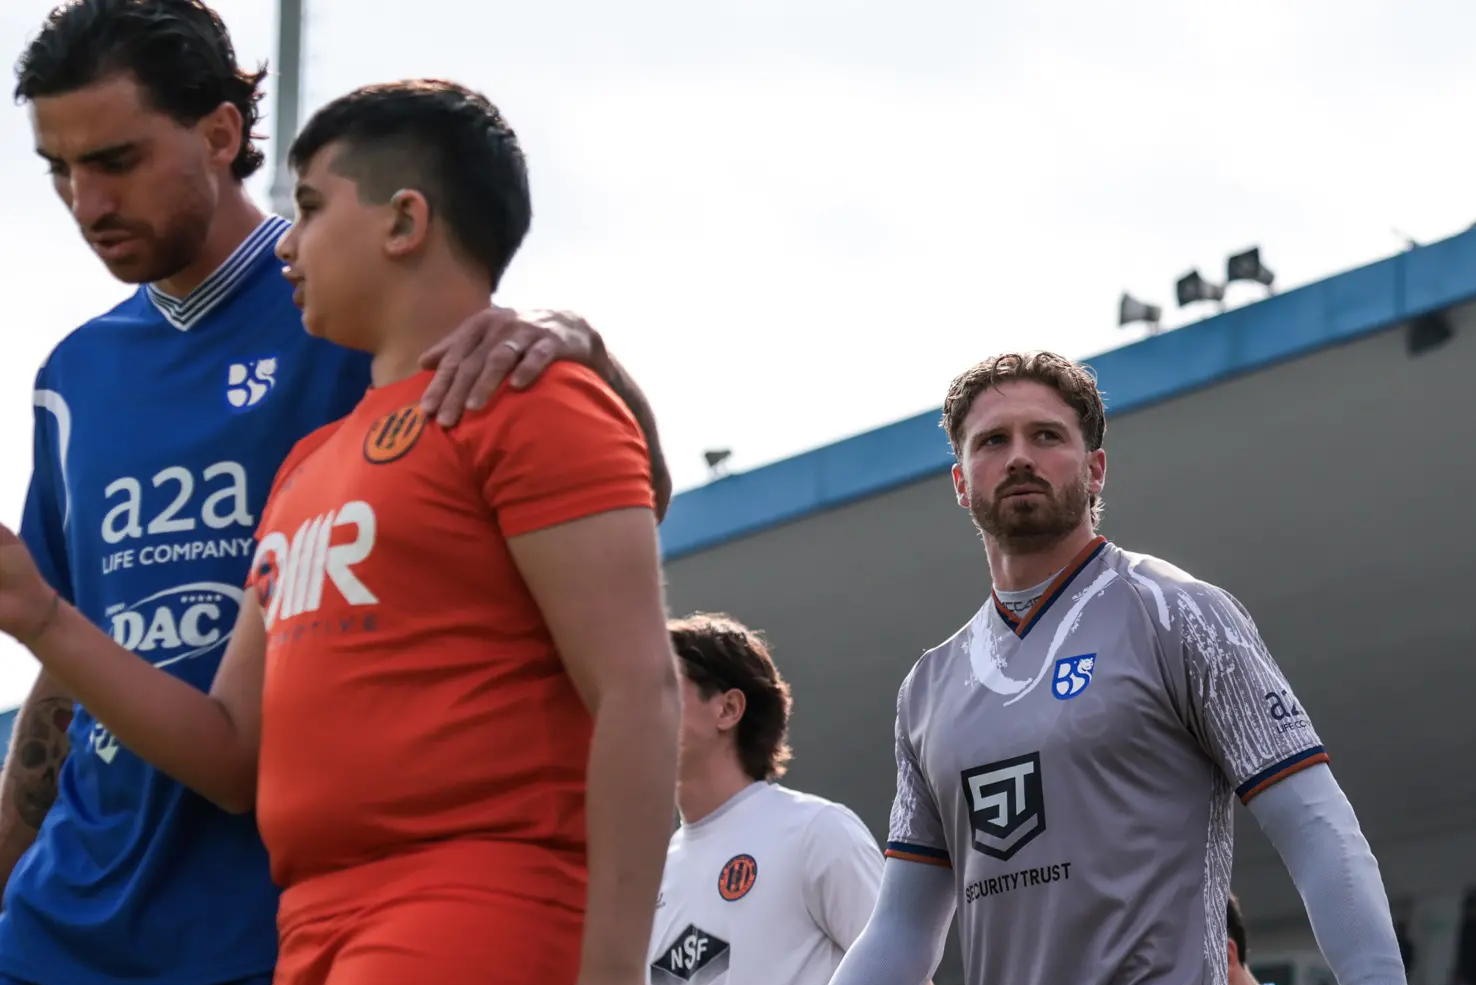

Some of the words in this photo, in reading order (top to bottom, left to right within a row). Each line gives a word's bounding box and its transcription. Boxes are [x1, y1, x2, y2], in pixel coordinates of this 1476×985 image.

[101, 461, 255, 544] a2a
[102, 549, 134, 574] LIFE
[139, 538, 253, 565] COMPANY
[112, 603, 221, 651] DAC
[1277, 722, 1295, 734] LIFE
[670, 934, 709, 972] NSF
